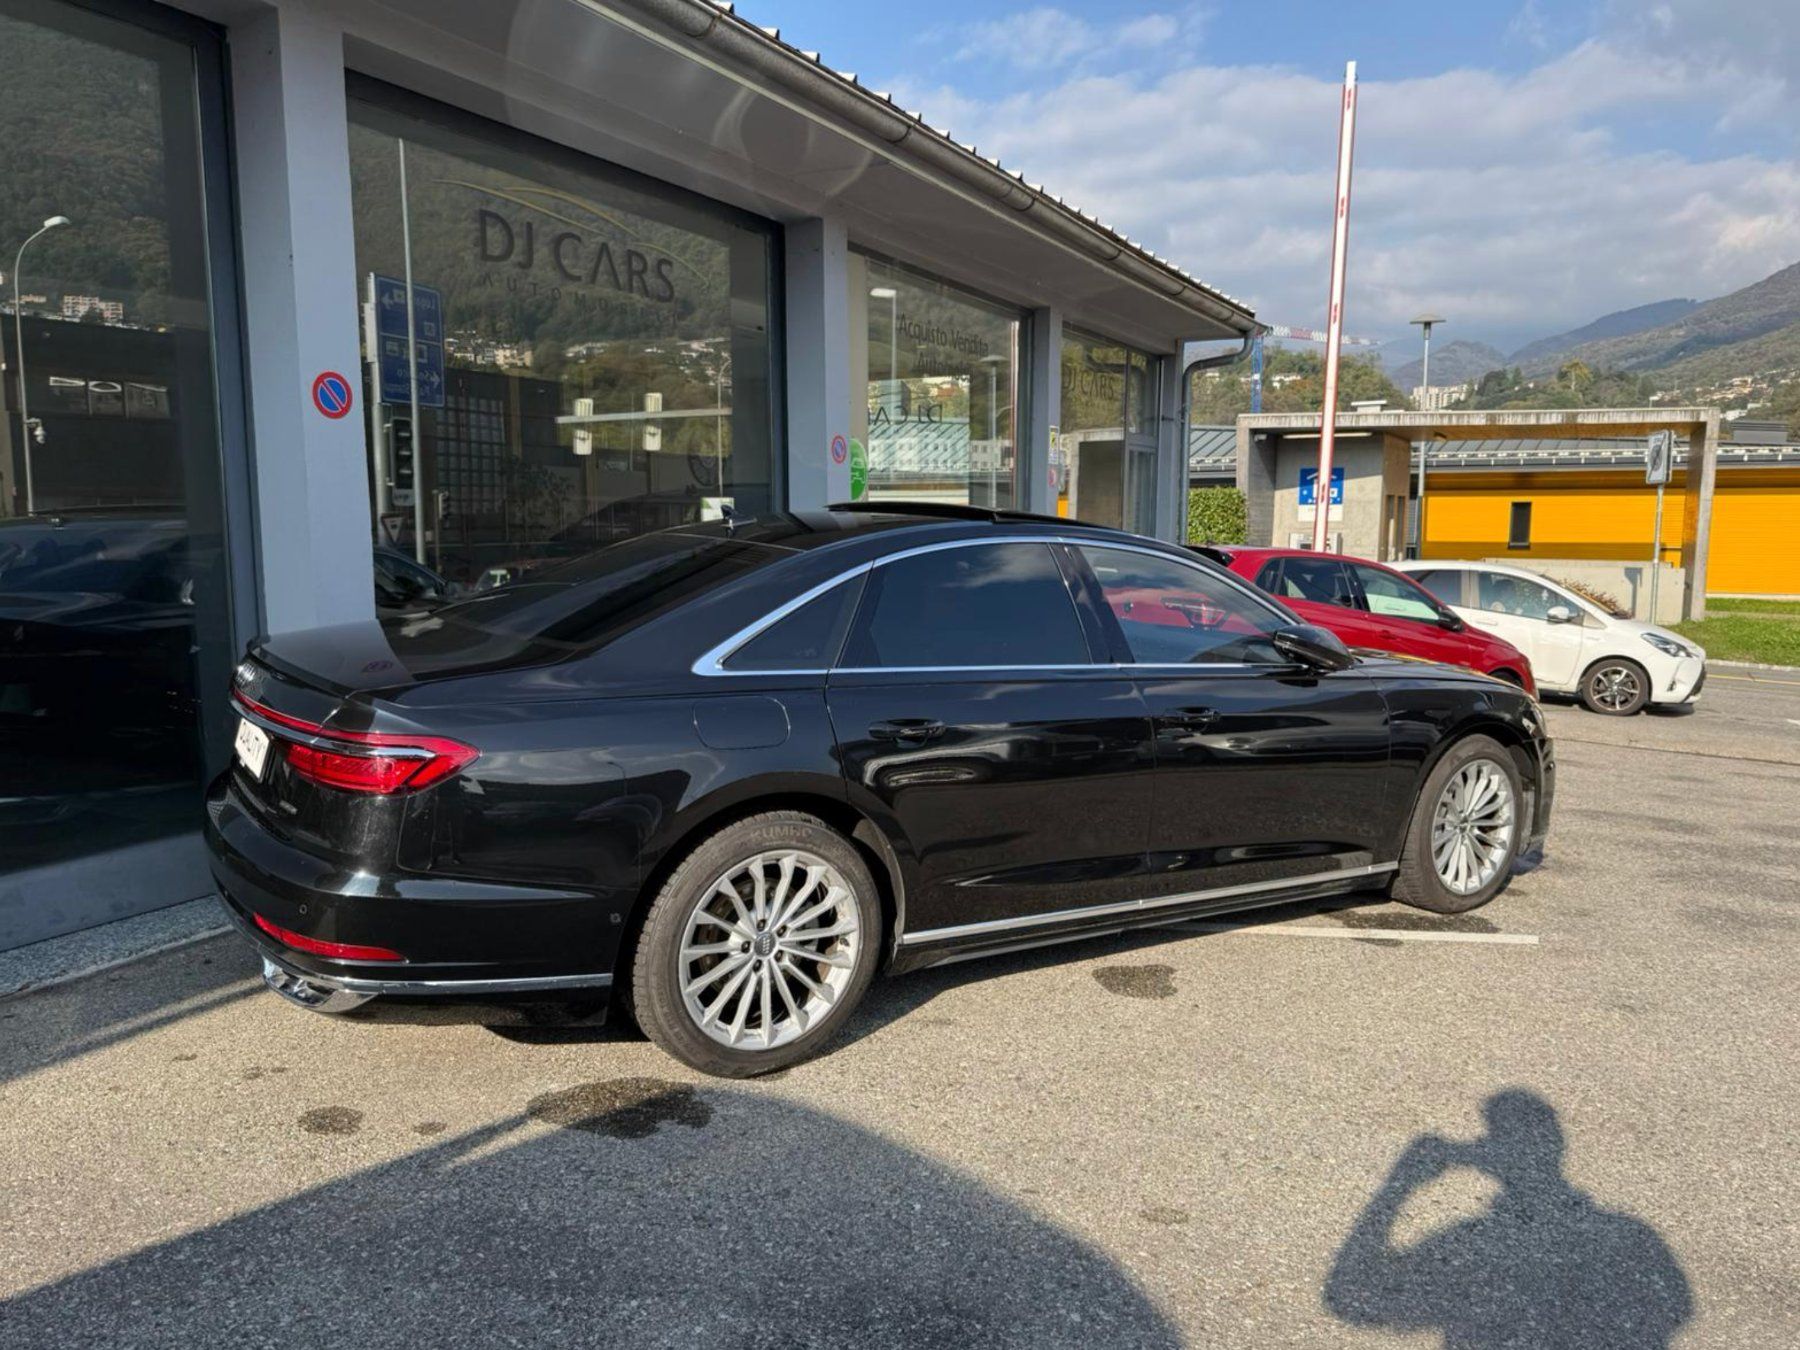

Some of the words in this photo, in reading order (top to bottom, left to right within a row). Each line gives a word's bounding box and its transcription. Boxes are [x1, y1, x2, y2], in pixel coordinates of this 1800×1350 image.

[478, 209, 534, 270] DJ
[555, 231, 675, 303] CARS
[898, 312, 948, 347] Acquisto
[951, 329, 989, 358] Vendita
[1080, 369, 1115, 401] CARS
